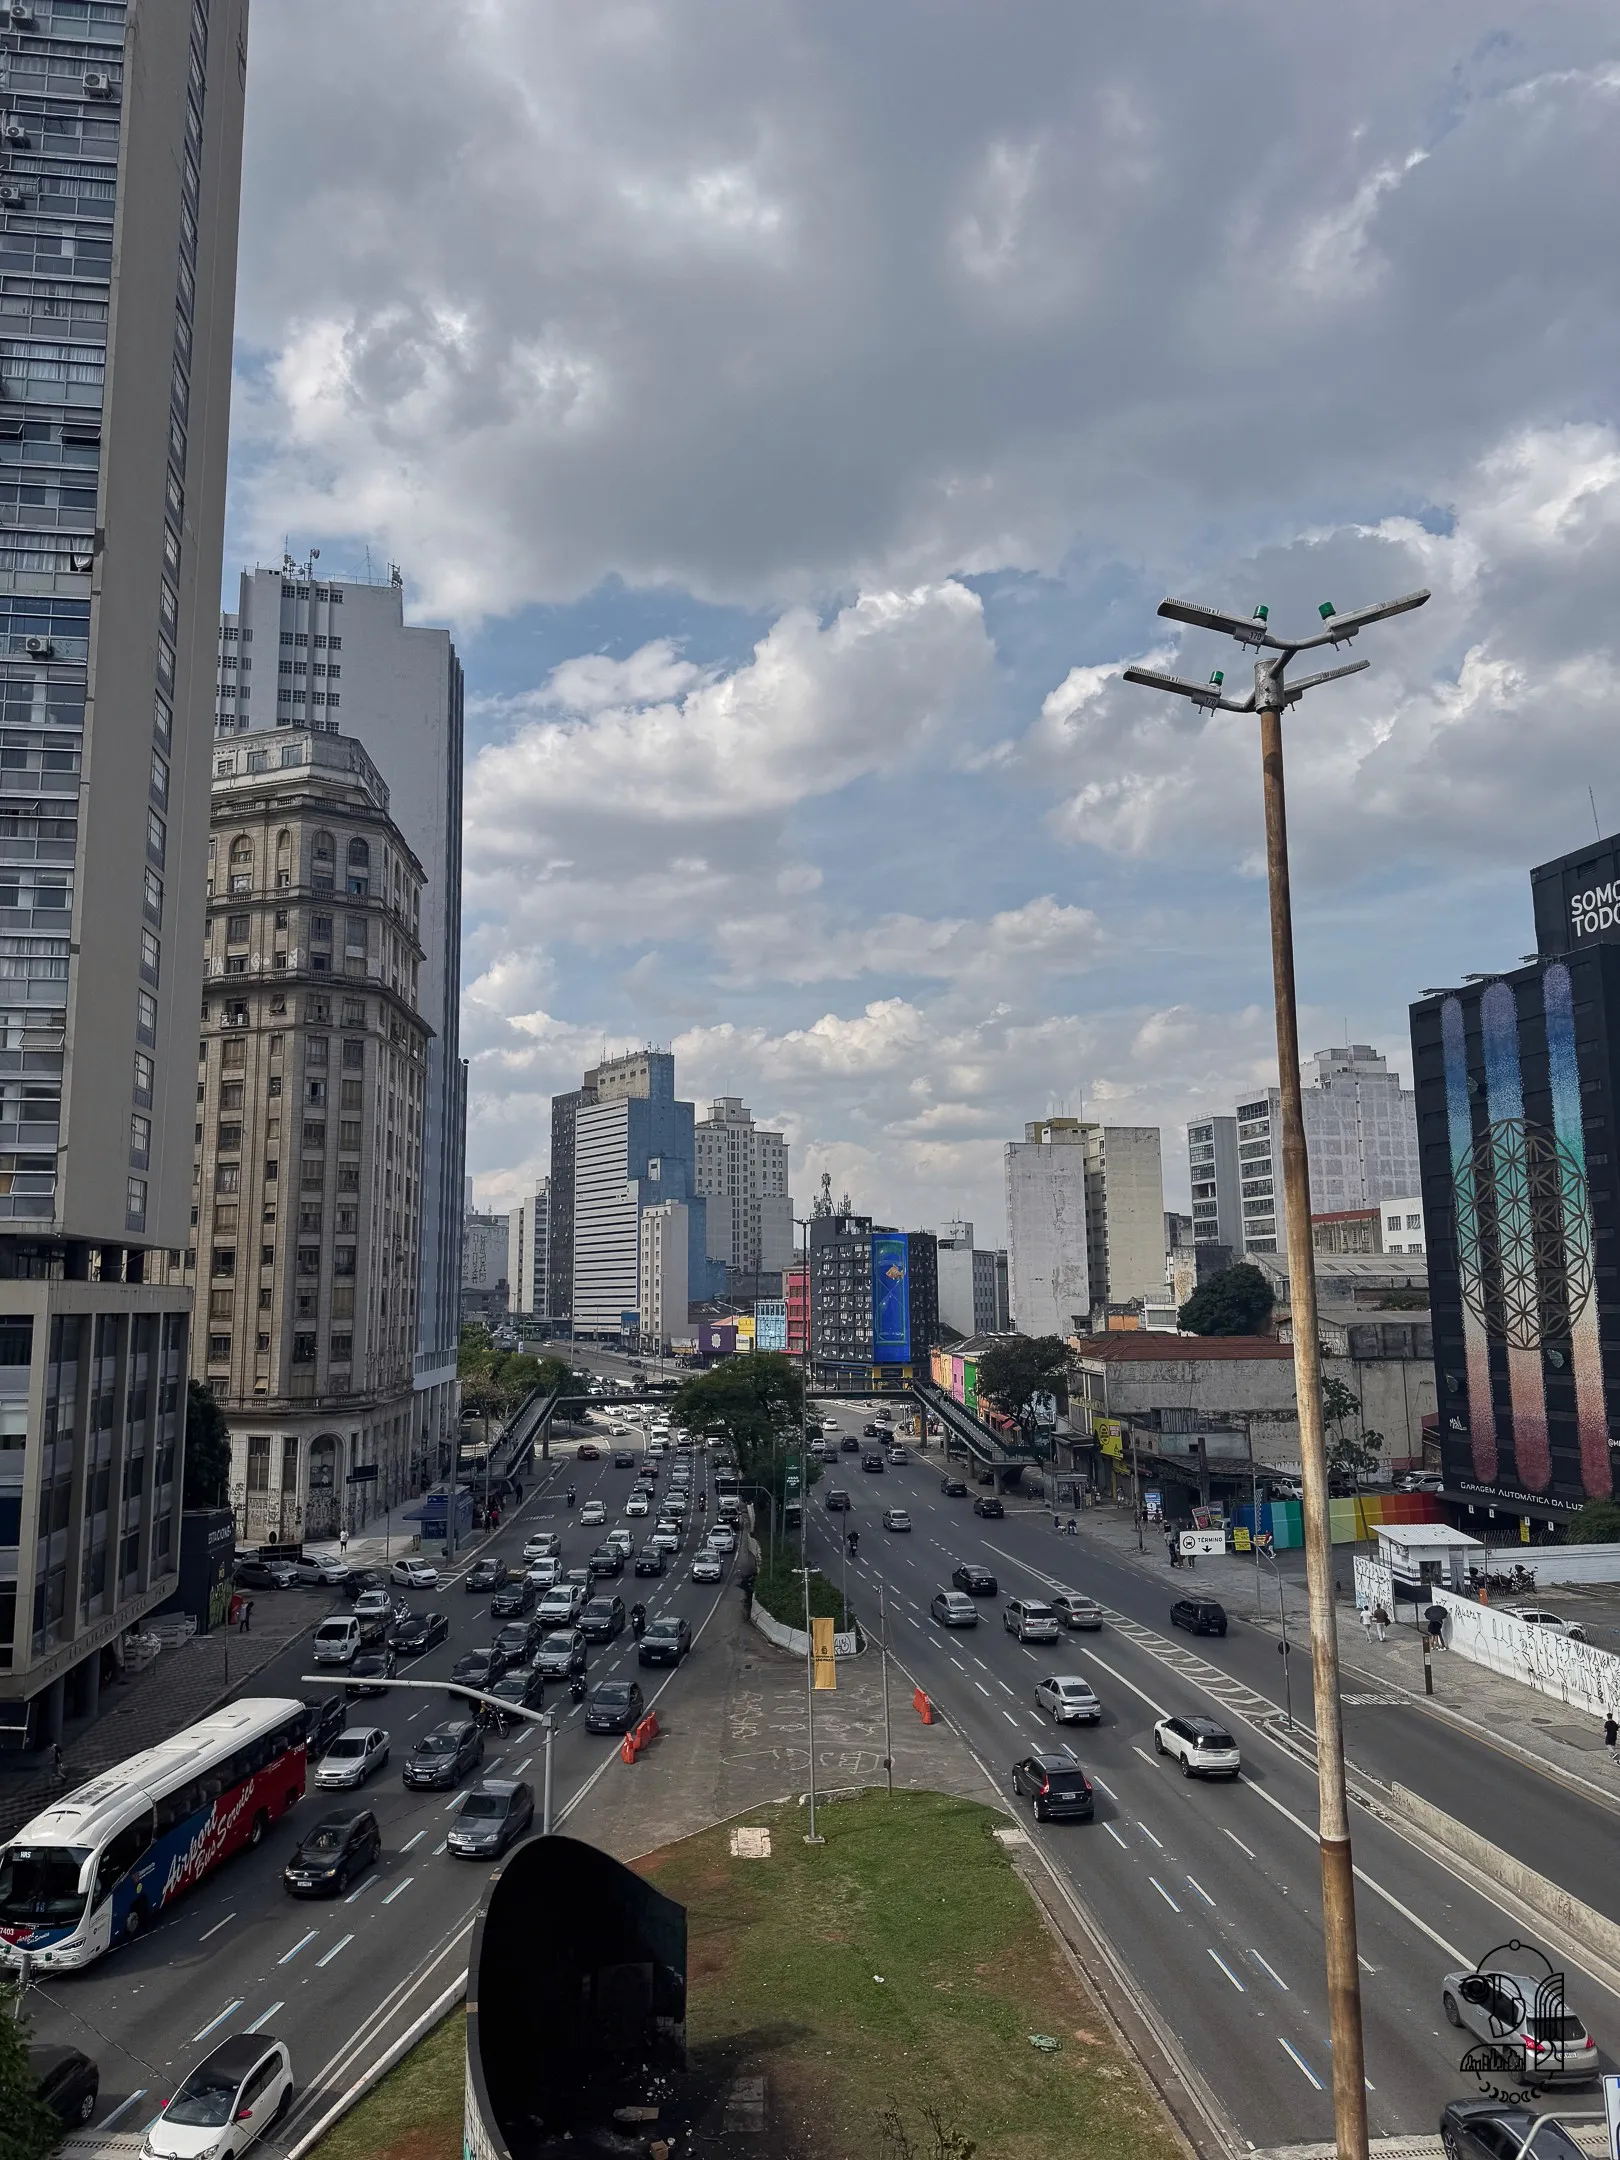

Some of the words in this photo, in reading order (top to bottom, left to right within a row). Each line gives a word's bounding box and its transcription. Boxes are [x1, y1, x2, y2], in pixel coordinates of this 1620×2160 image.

[1460, 1481, 1496, 1494] GARAGEM
[1498, 1489, 1550, 1505] AUTOMÁTICA
[1551, 1499, 1564, 1508] DA
[1565, 1501, 1584, 1511] LUZ
[160, 1800, 218, 1908] Airport
[195, 1840, 216, 1879] Bus
[217, 1778, 255, 1848] Service
